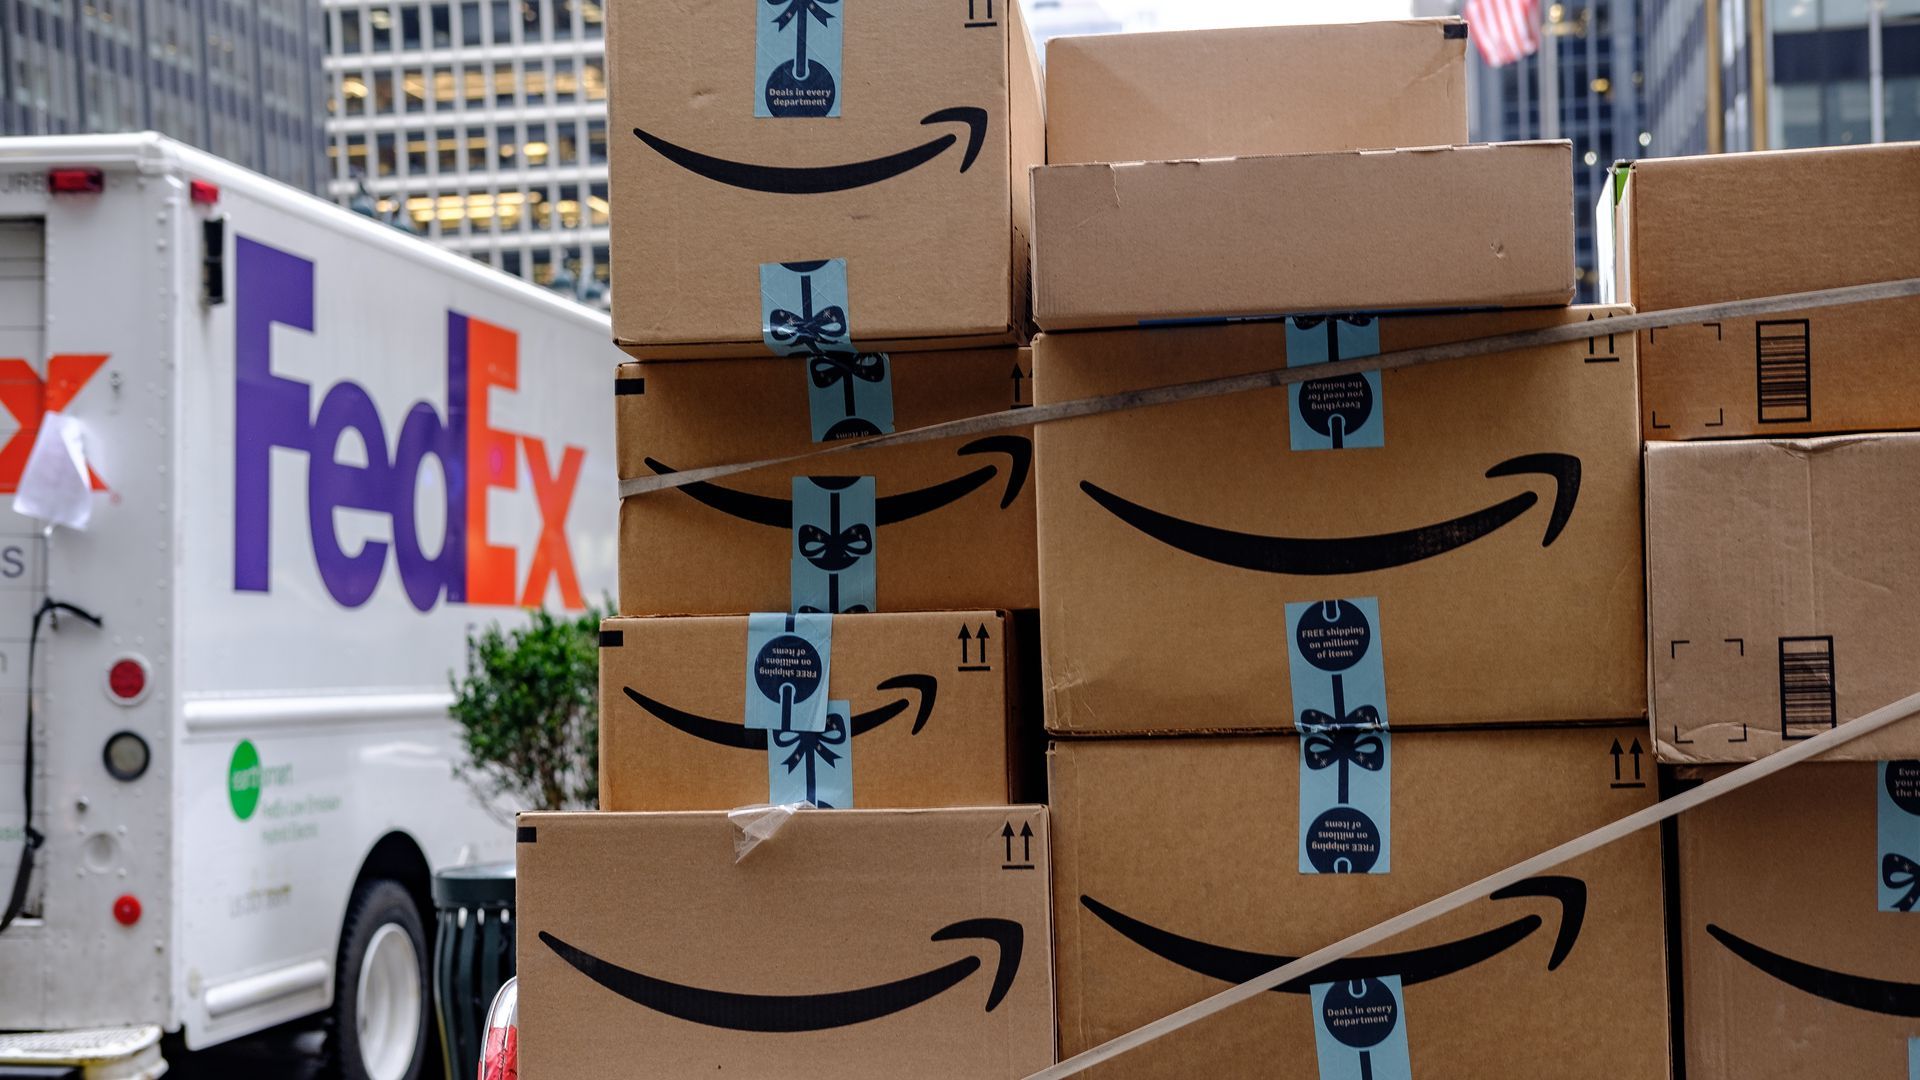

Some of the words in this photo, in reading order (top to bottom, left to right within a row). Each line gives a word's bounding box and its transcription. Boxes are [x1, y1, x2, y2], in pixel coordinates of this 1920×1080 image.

[769, 88, 794, 96] Deals
[795, 87, 804, 96] in
[806, 89, 831, 98] every
[773, 97, 827, 107] department
[1308, 382, 1346, 391] holidays
[1347, 380, 1363, 389] the
[1308, 393, 1321, 401] for
[1323, 391, 1345, 400] need
[1347, 390, 1364, 398] you
[1311, 401, 1361, 411] Everything
[234, 234, 587, 613] FedEx
[1301, 628, 1325, 639] FREE
[1326, 625, 1365, 637] shipping
[1309, 641, 1321, 649] on
[1322, 638, 1359, 648] millions
[772, 647, 795, 657] items
[796, 648, 806, 657] of
[1316, 649, 1326, 659] of
[1328, 649, 1353, 659] items
[766, 657, 799, 667] millions
[801, 658, 812, 666] on
[759, 666, 795, 678] shipping
[796, 670, 817, 679] FREE
[1896, 788, 1912, 797] the
[1325, 820, 1350, 830] items
[1351, 820, 1362, 830] of
[1318, 830, 1355, 841] millions
[1356, 831, 1368, 839] on
[1311, 840, 1350, 852] shipping
[1351, 843, 1375, 852] FREE
[1327, 1007, 1353, 1017] Deals
[1354, 1005, 1364, 1015] in
[1366, 1004, 1392, 1014] every
[1333, 1014, 1389, 1028] department
